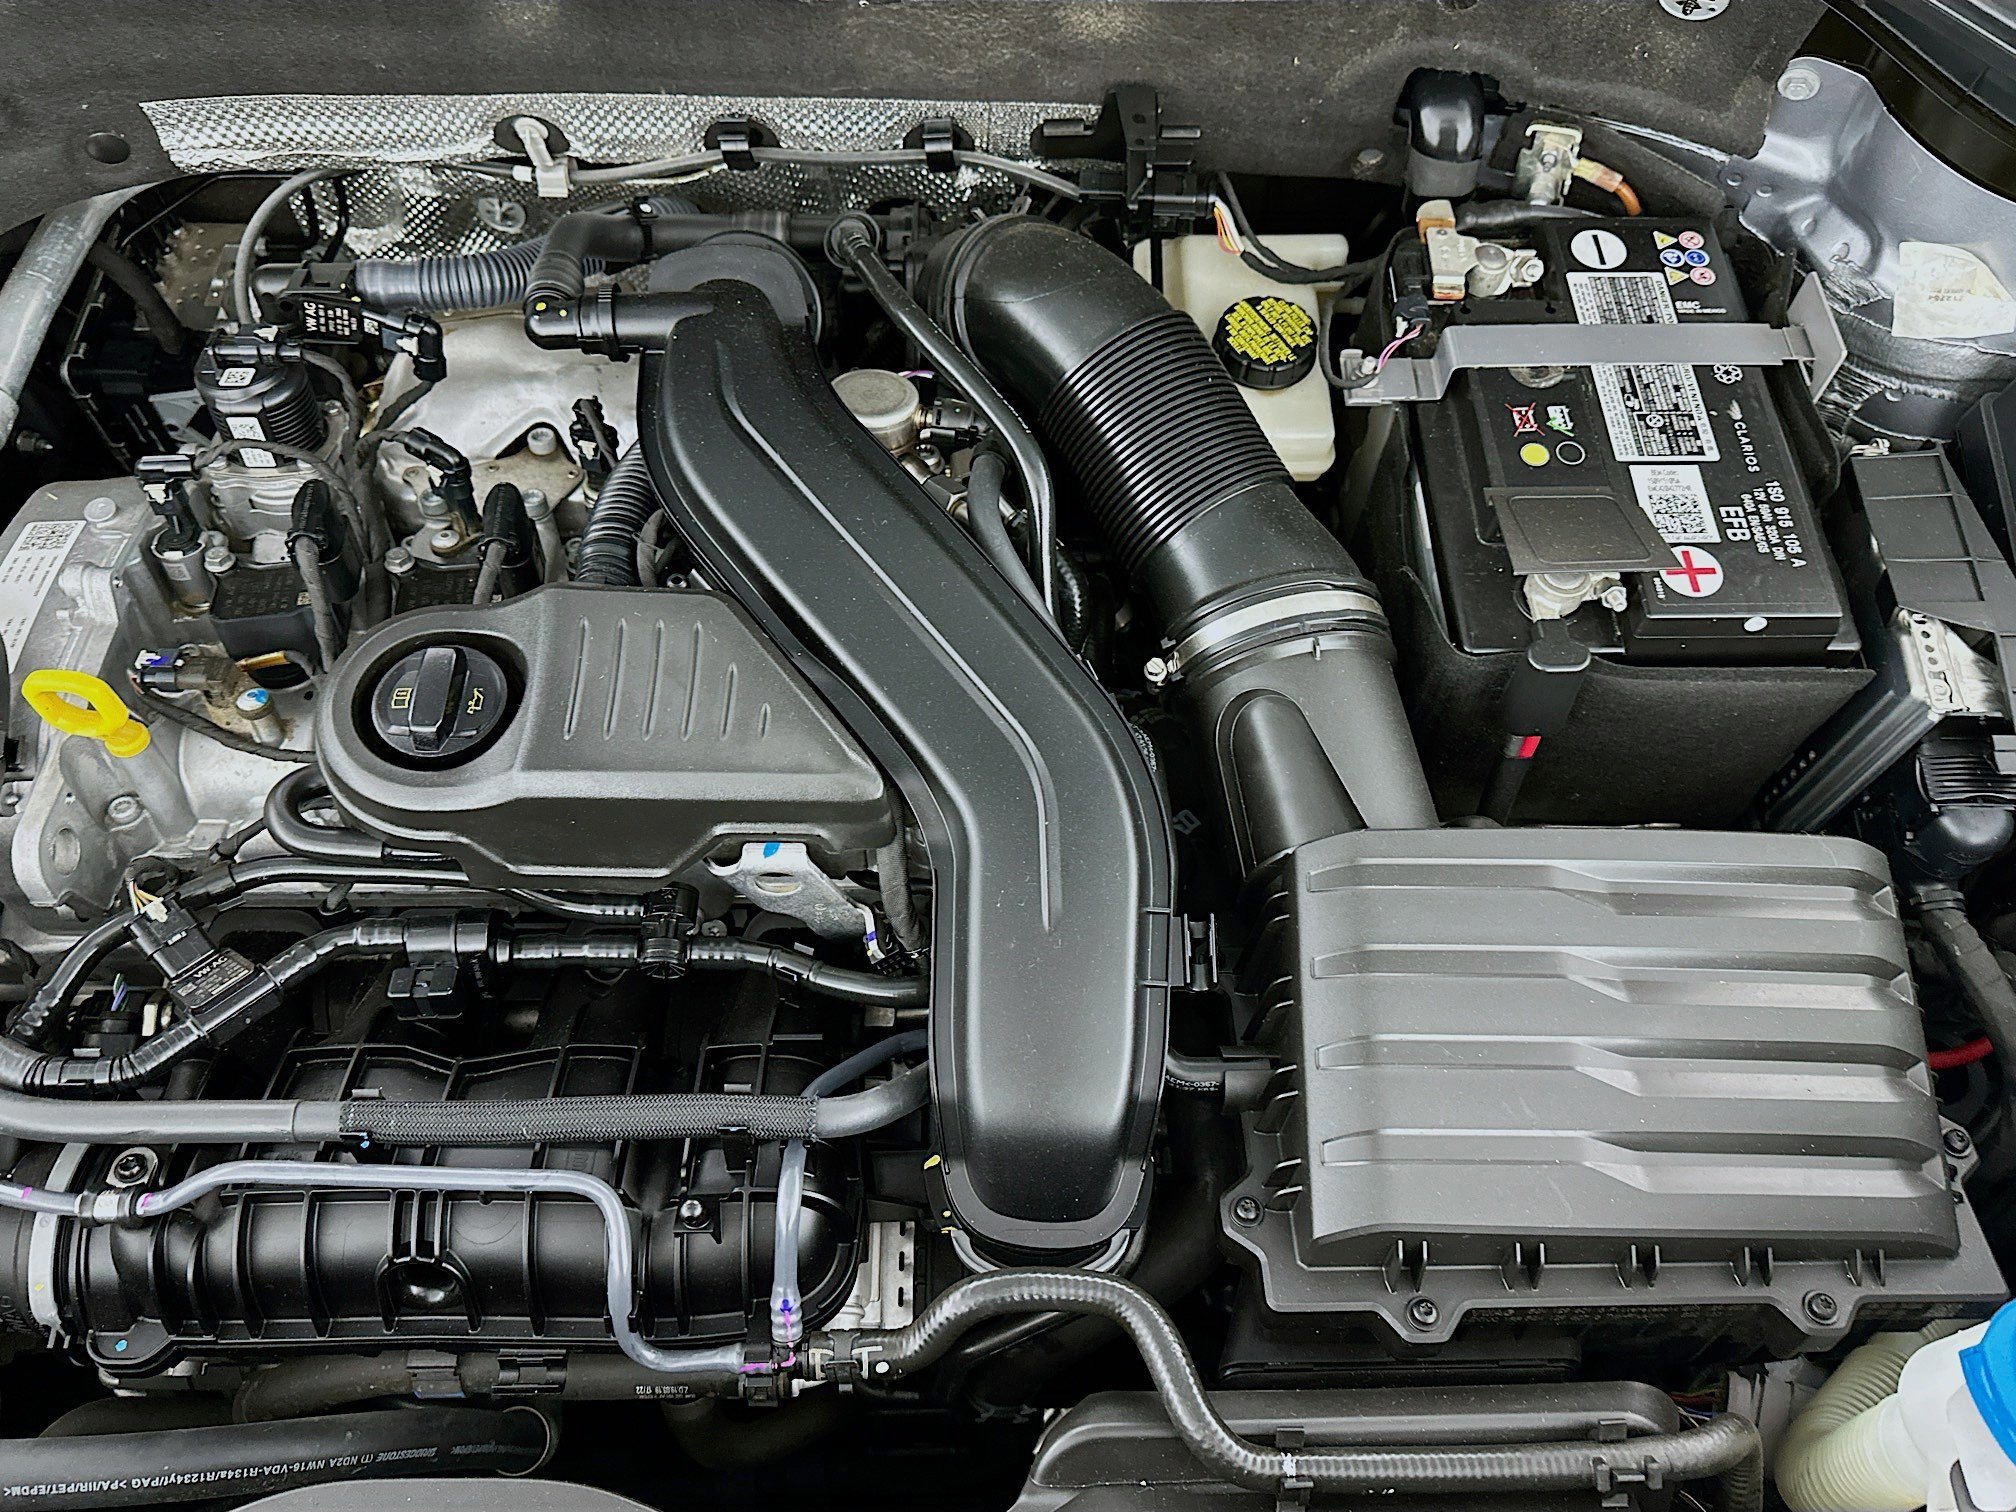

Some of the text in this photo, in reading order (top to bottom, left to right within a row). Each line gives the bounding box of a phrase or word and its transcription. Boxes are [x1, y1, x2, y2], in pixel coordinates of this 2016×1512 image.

[303, 302, 318, 331] VW AG
[1734, 421, 1760, 473] CLARIOS
[1719, 506, 1751, 542] EFB
[1753, 487, 1767, 501] 12V
[1772, 546, 1786, 561] DIN
[1774, 506, 1794, 528] 915
[1783, 533, 1802, 554] 105
[1790, 558, 1807, 568] A
[330, 1455, 357, 1467] ND2A
